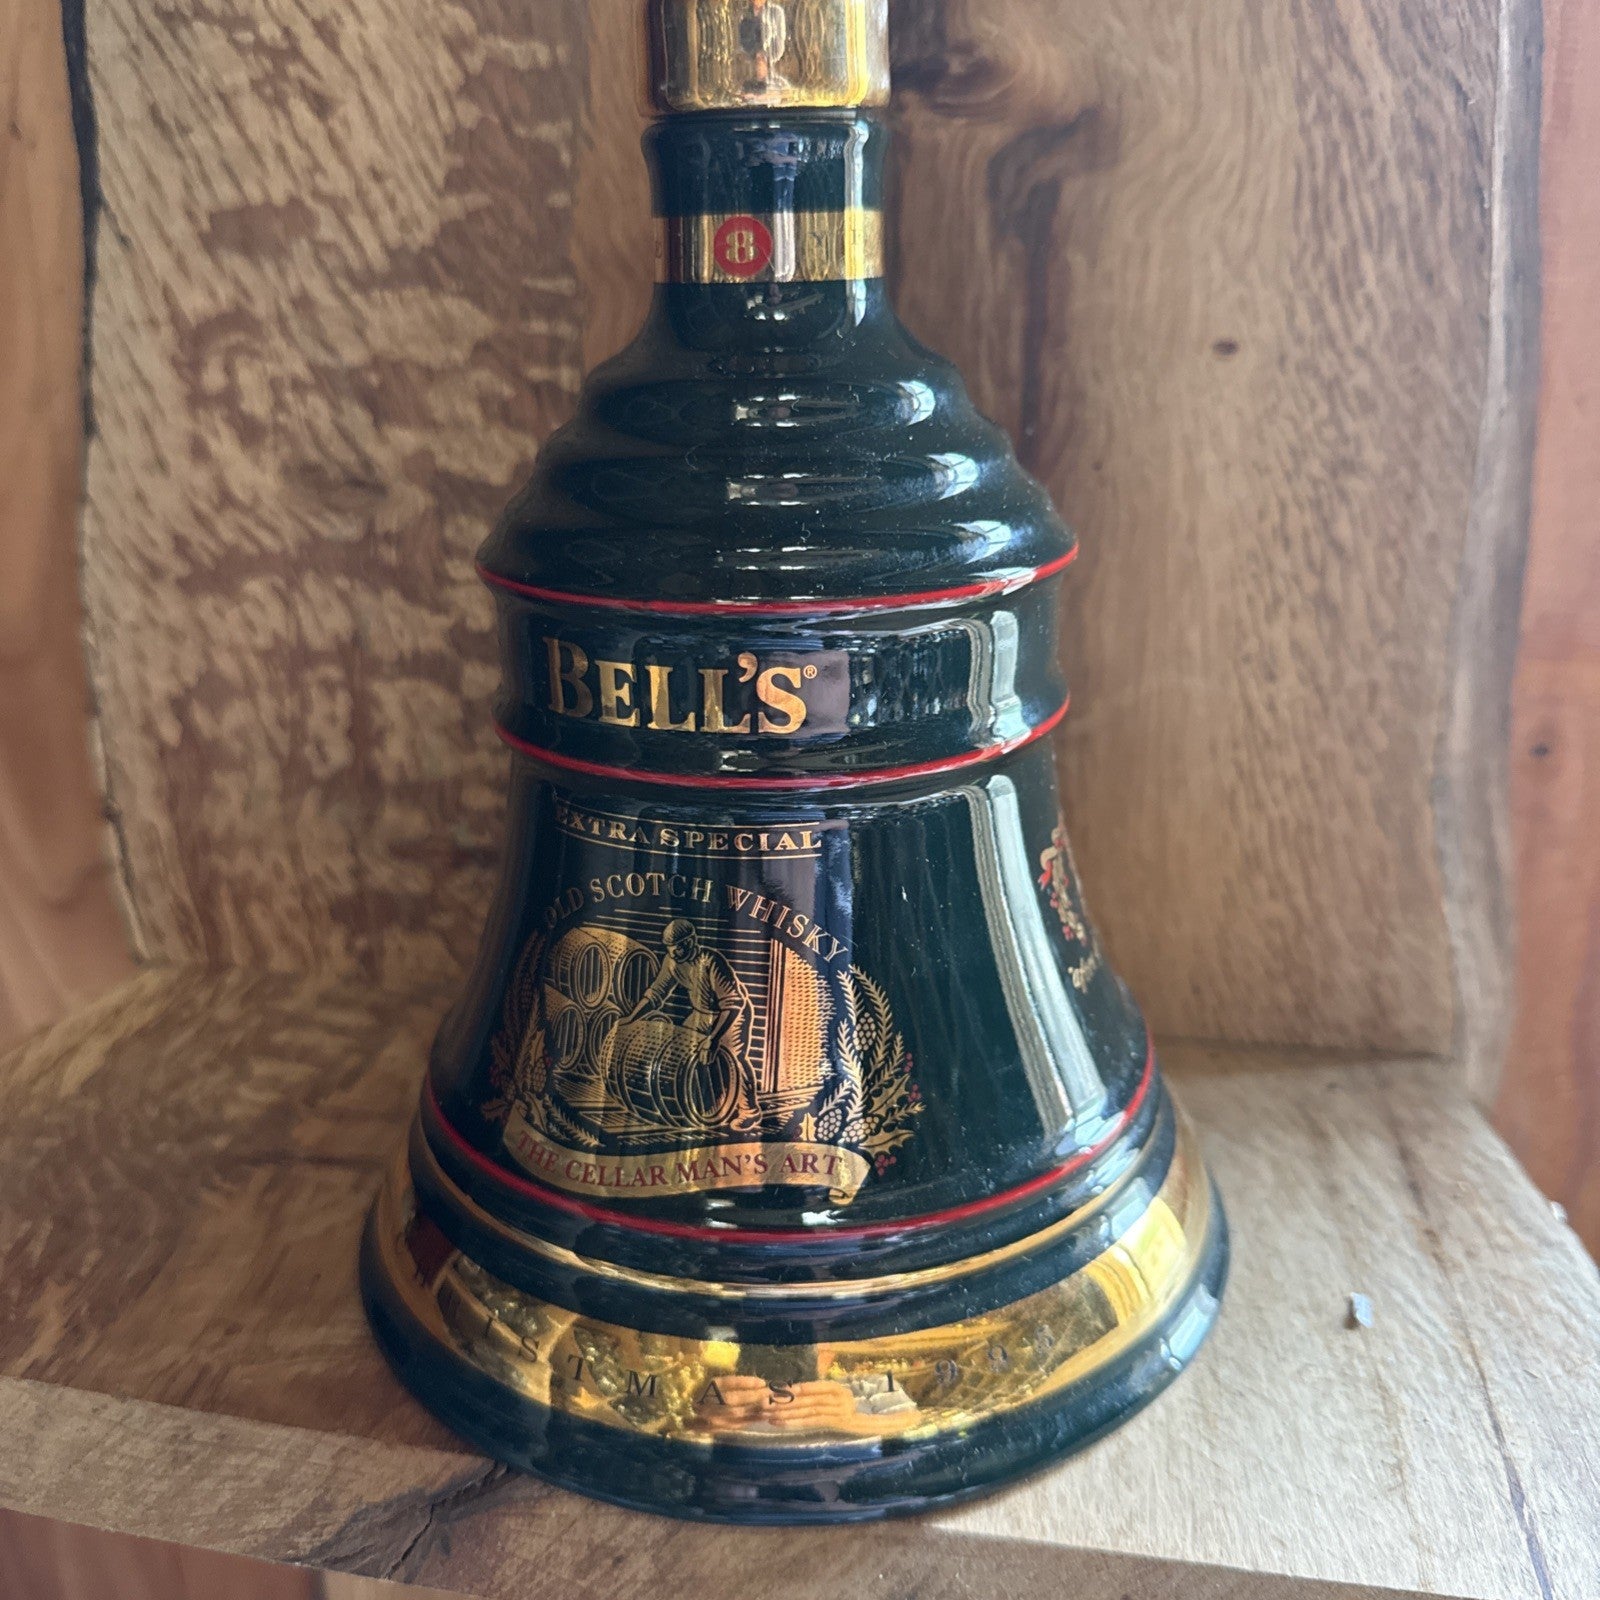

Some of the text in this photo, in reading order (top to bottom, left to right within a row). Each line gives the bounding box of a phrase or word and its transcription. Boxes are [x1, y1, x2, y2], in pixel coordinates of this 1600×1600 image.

[725, 230, 755, 264] 8
[554, 806, 823, 851] EXTRA SPECIAL
[542, 871, 849, 963] OLD SCOTCH WHISKY
[516, 1130, 843, 1188] THE CELLAR MAN'S ART
